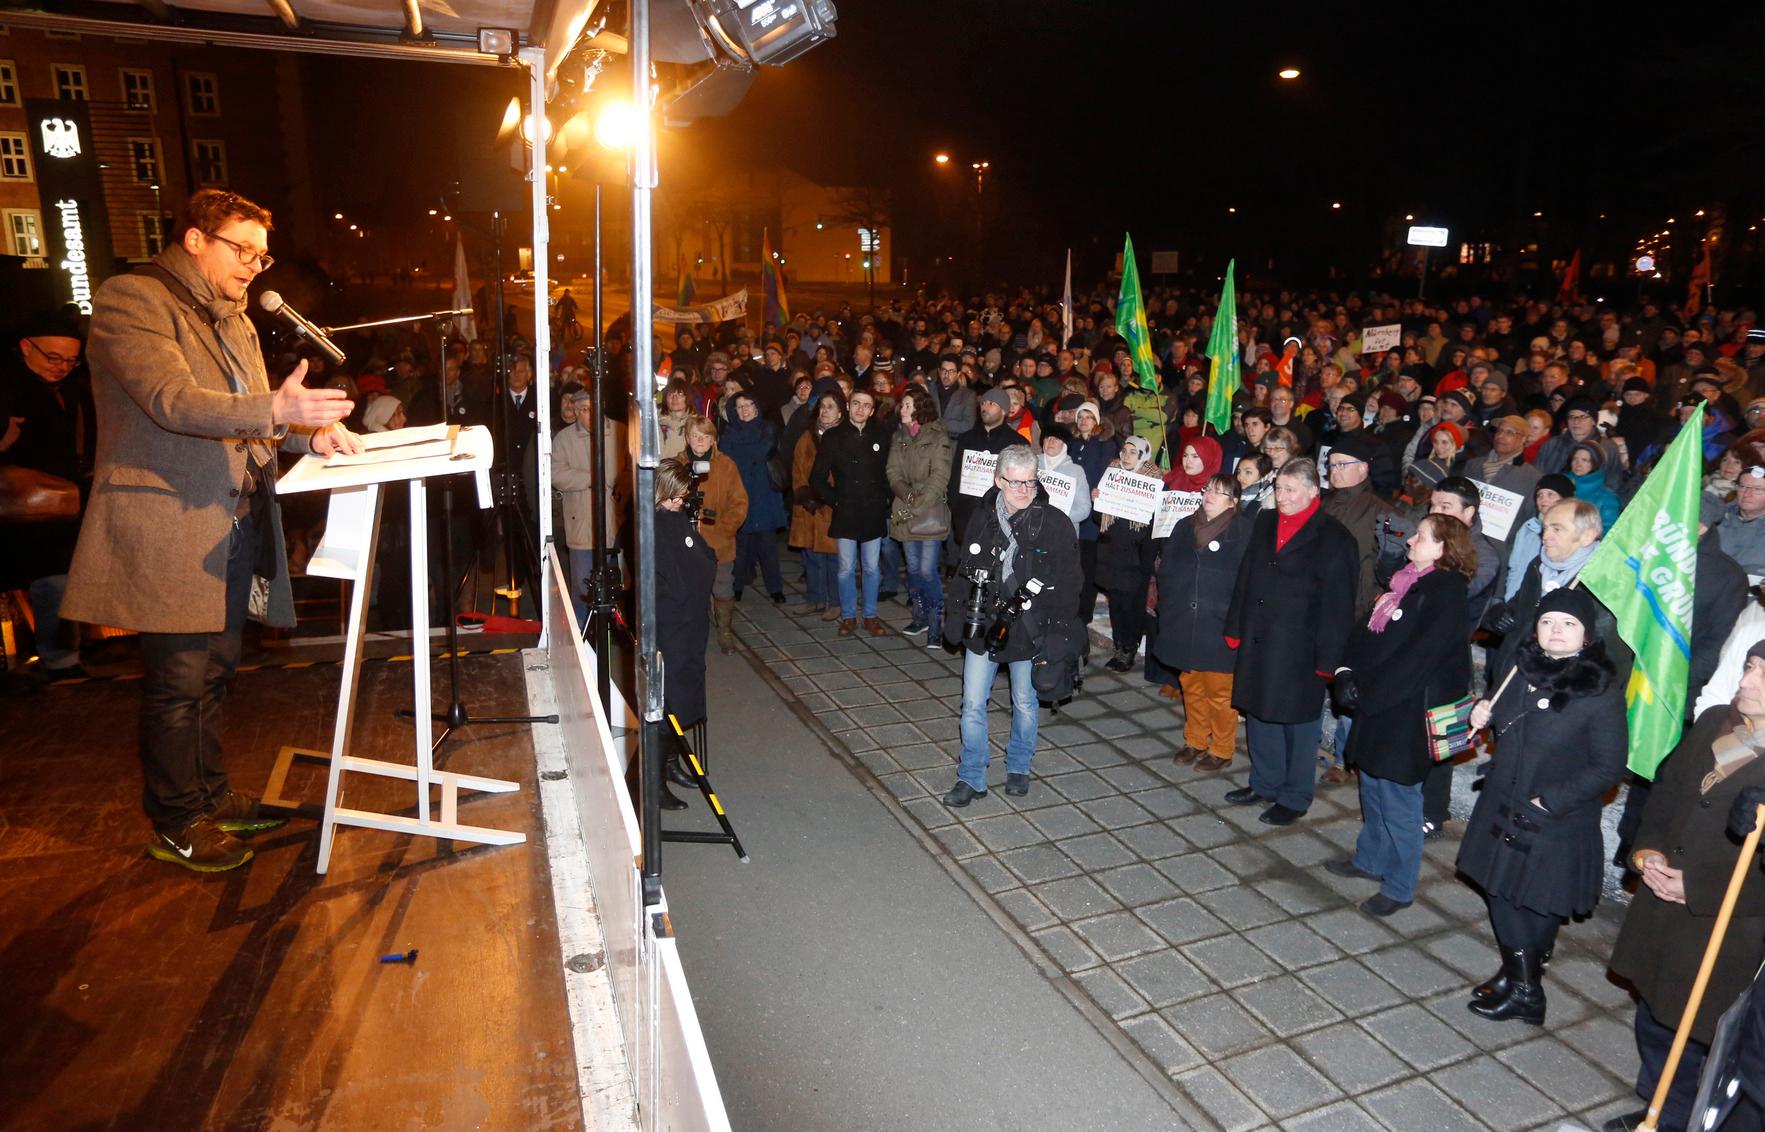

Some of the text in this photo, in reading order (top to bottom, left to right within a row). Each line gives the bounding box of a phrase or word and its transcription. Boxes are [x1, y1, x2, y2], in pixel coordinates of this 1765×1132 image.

[966, 452, 997, 468] NÜRNBE
[1108, 469, 1156, 492] NÜRNBERG
[1120, 486, 1155, 500] ZUSAMMEN
[1162, 491, 1202, 506] NÜRNBER
[1651, 509, 1698, 585] BÜND
